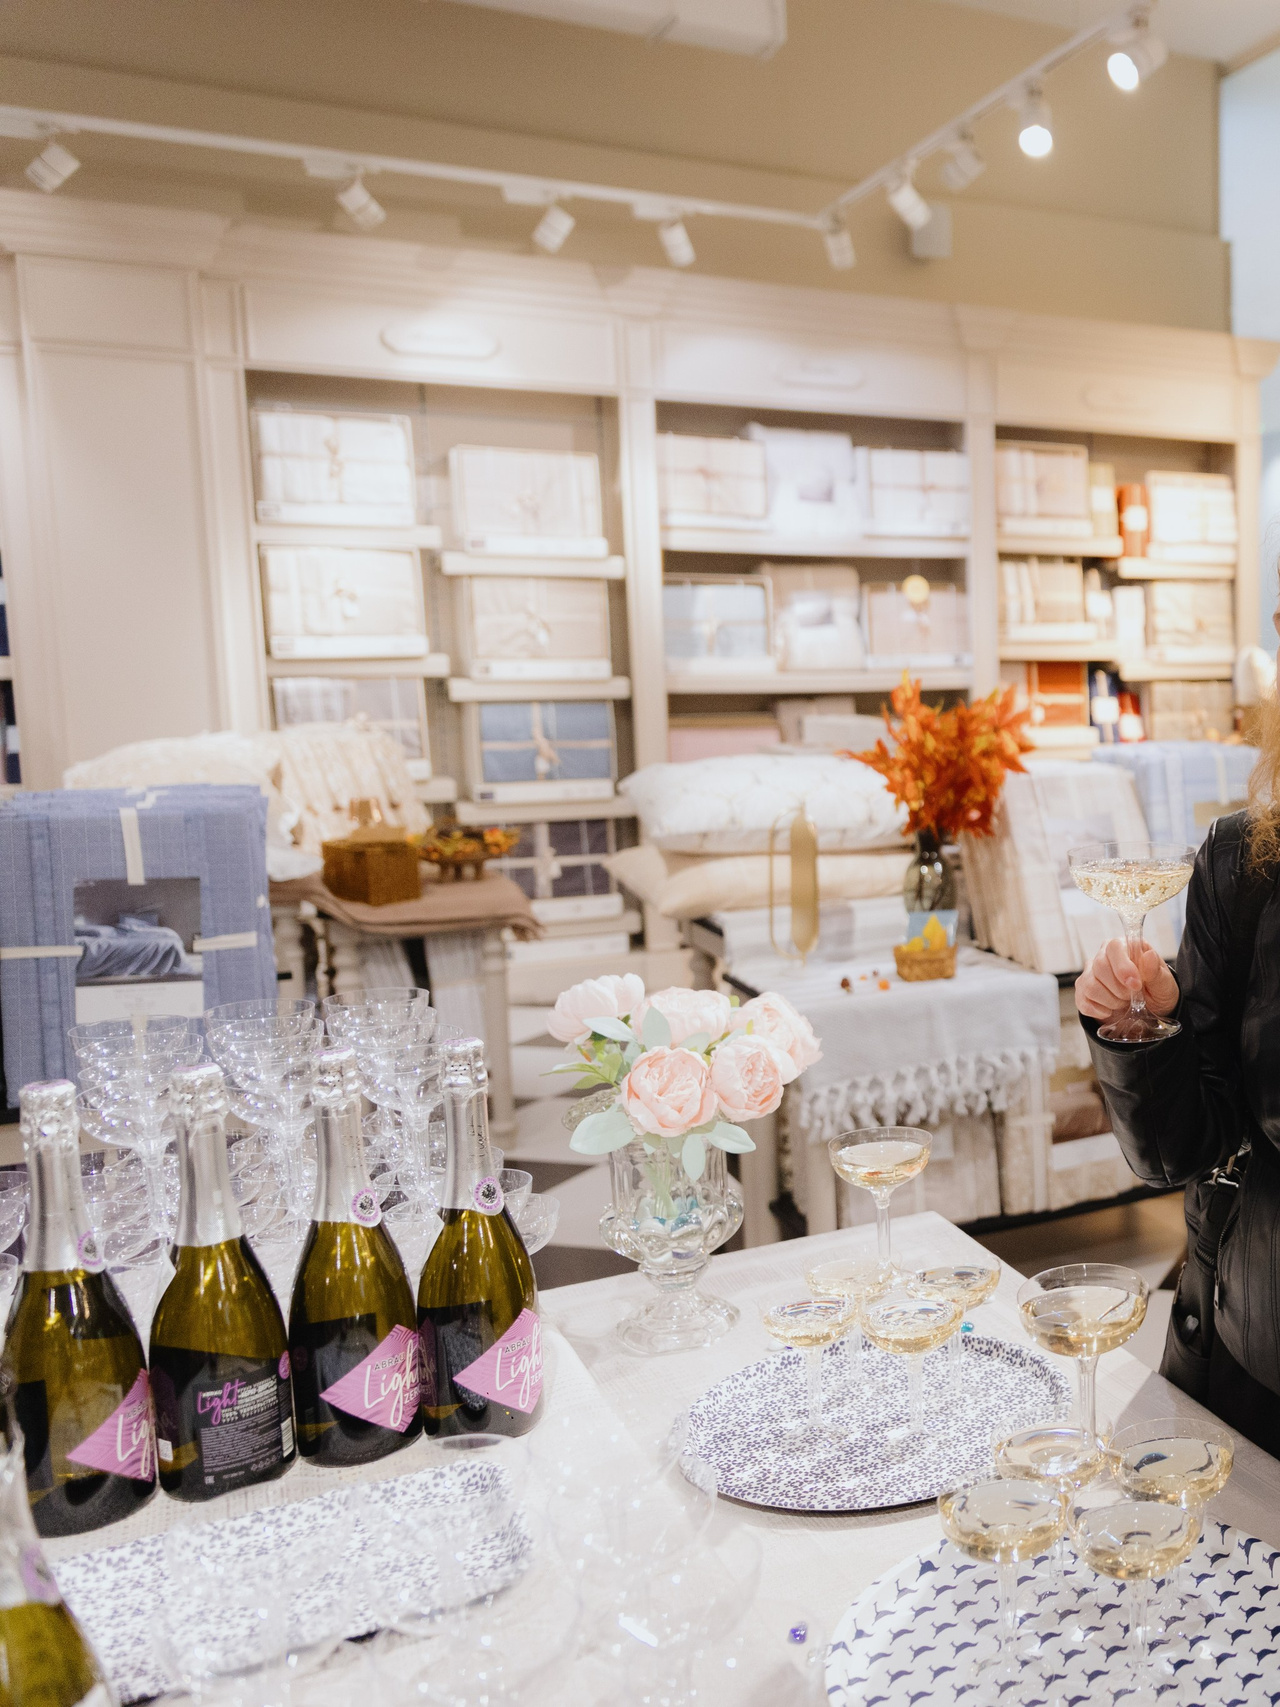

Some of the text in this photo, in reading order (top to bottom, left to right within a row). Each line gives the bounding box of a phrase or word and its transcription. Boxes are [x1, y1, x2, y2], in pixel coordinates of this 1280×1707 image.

[503, 1335, 532, 1354] ABRAU
[374, 1352, 406, 1371] ABRAU
[197, 1379, 247, 1426] Light
[117, 1412, 151, 1478] Lig
